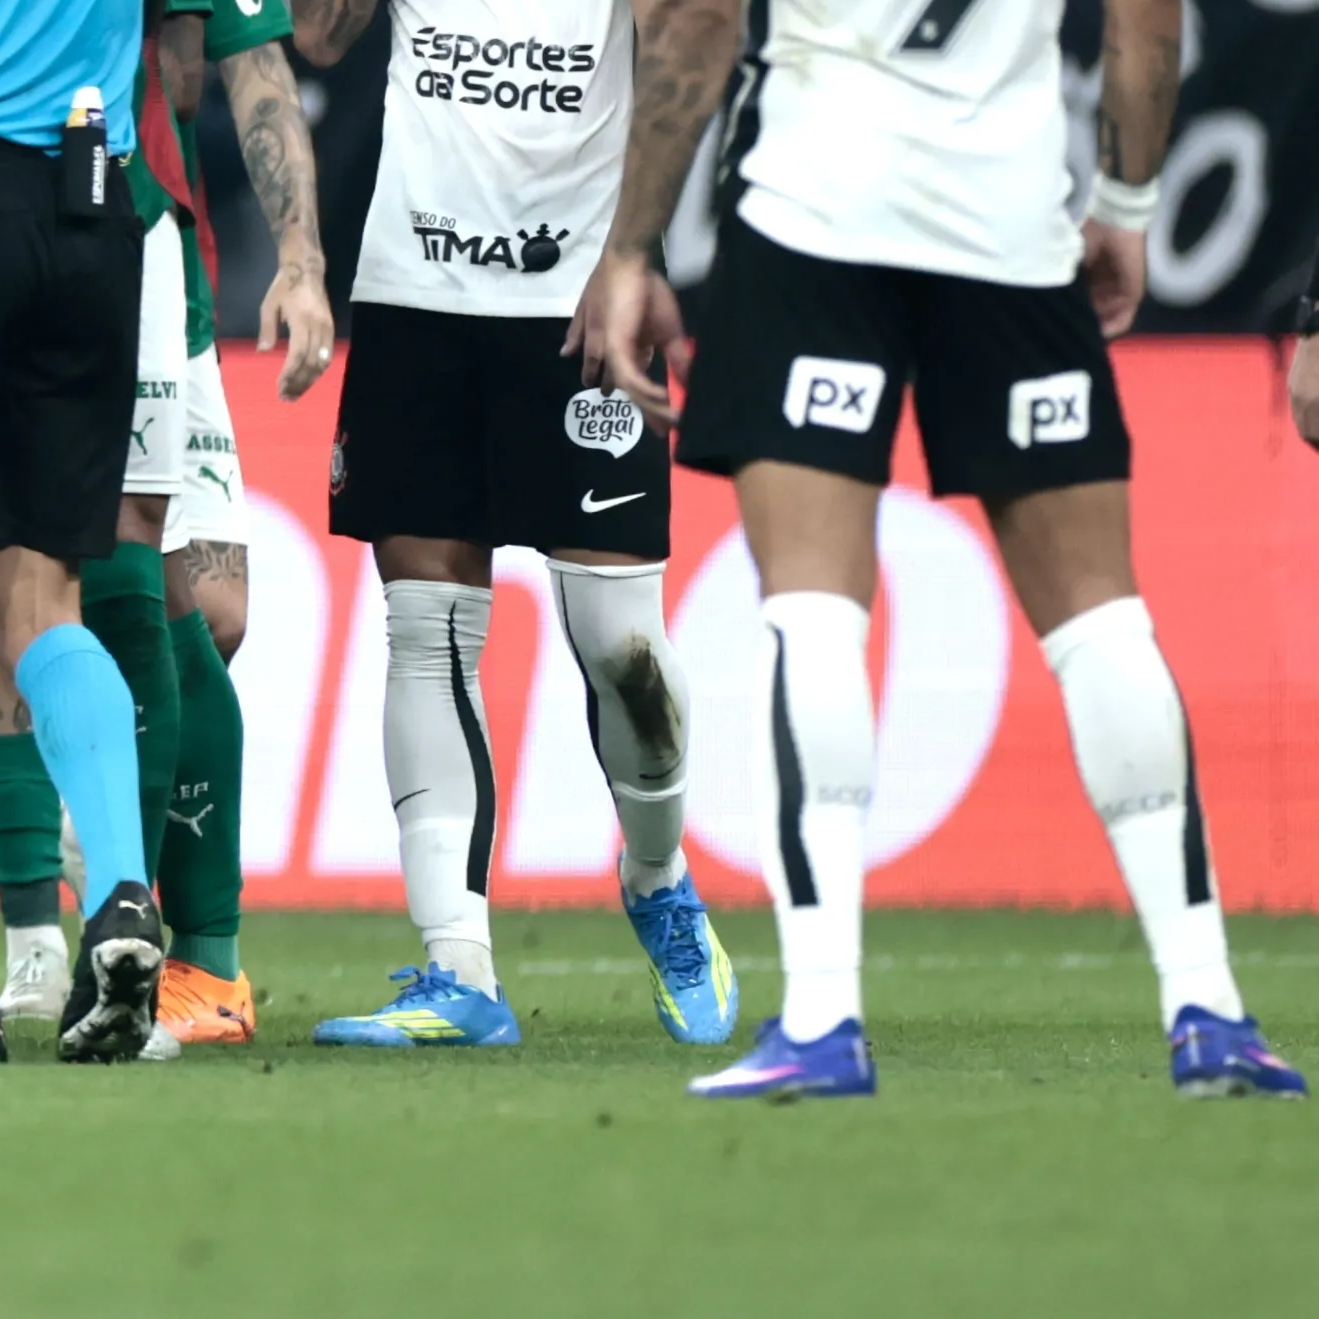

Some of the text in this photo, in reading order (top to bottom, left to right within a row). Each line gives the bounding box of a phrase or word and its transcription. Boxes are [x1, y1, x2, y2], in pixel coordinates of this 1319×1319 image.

[412, 26, 595, 73] Esportes
[459, 69, 583, 113] Sorte
[573, 399, 632, 419] Broto
[808, 377, 866, 423] px
[1030, 392, 1079, 432] px
[579, 417, 635, 442] Legal
